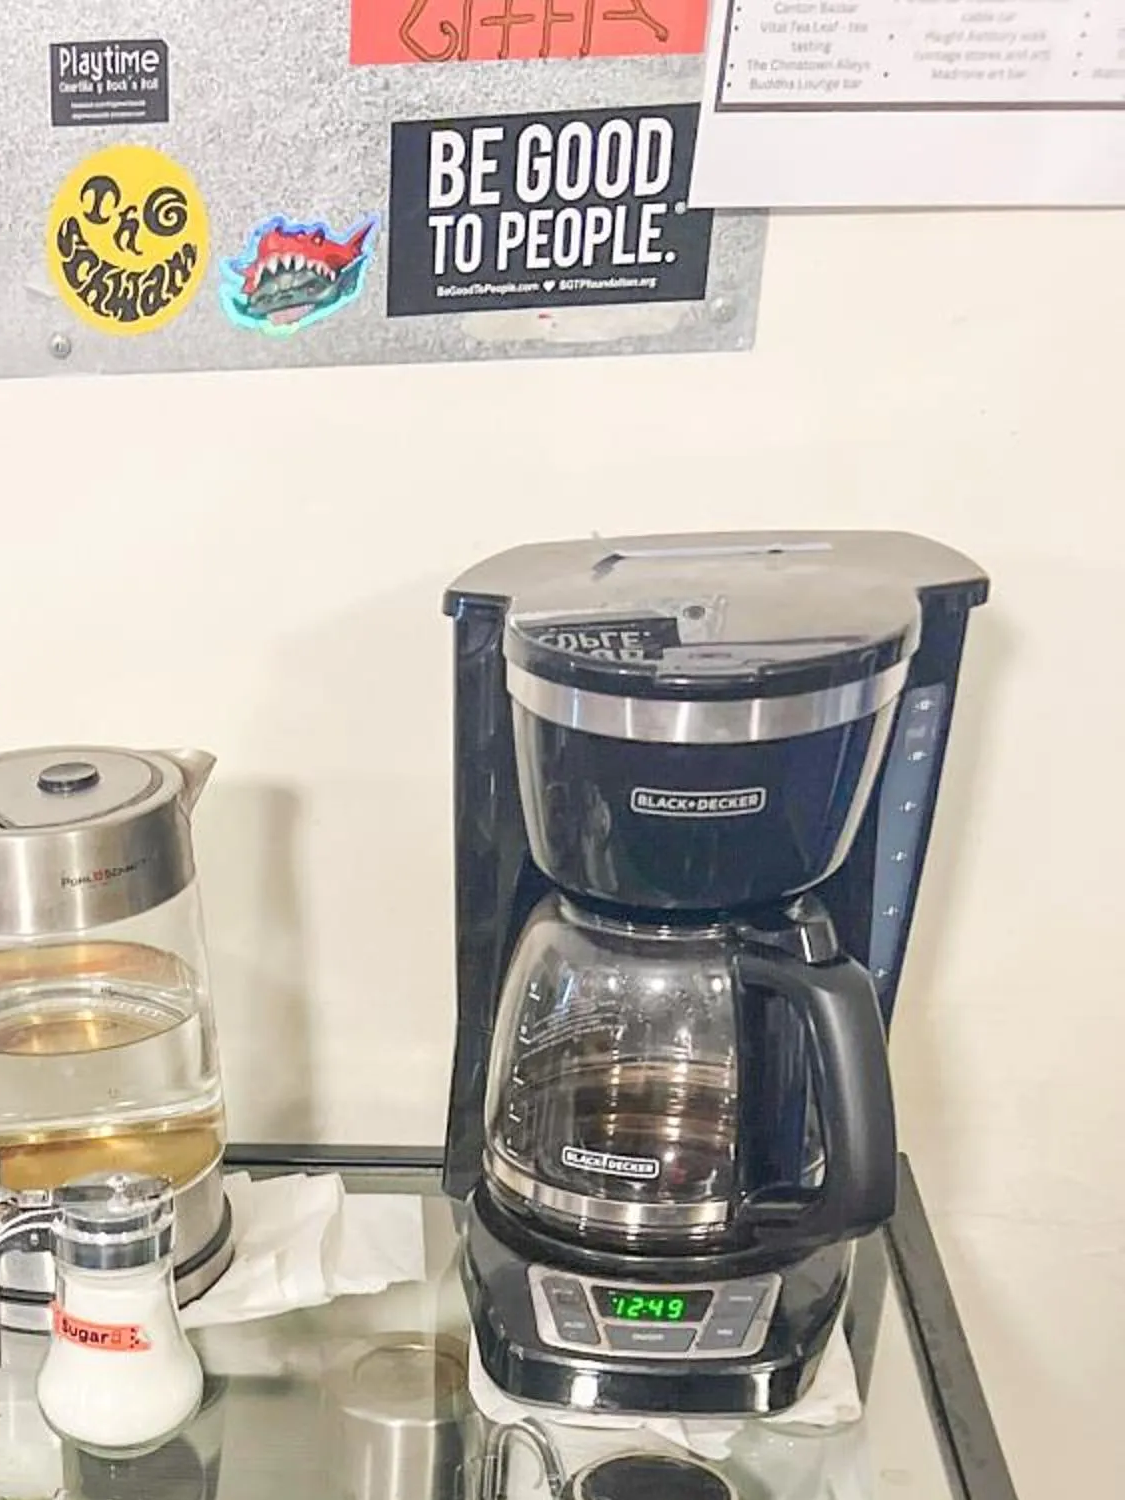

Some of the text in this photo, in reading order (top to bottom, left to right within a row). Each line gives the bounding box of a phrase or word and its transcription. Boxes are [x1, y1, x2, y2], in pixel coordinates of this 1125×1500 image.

[59, 44, 159, 80] Playtime
[747, 59, 767, 71] The
[428, 116, 674, 209] BE GOOD
[428, 202, 676, 275] TO PEOPLE.
[613, 1297, 684, 1320] 12:49
[61, 1317, 109, 1344] Sugar
